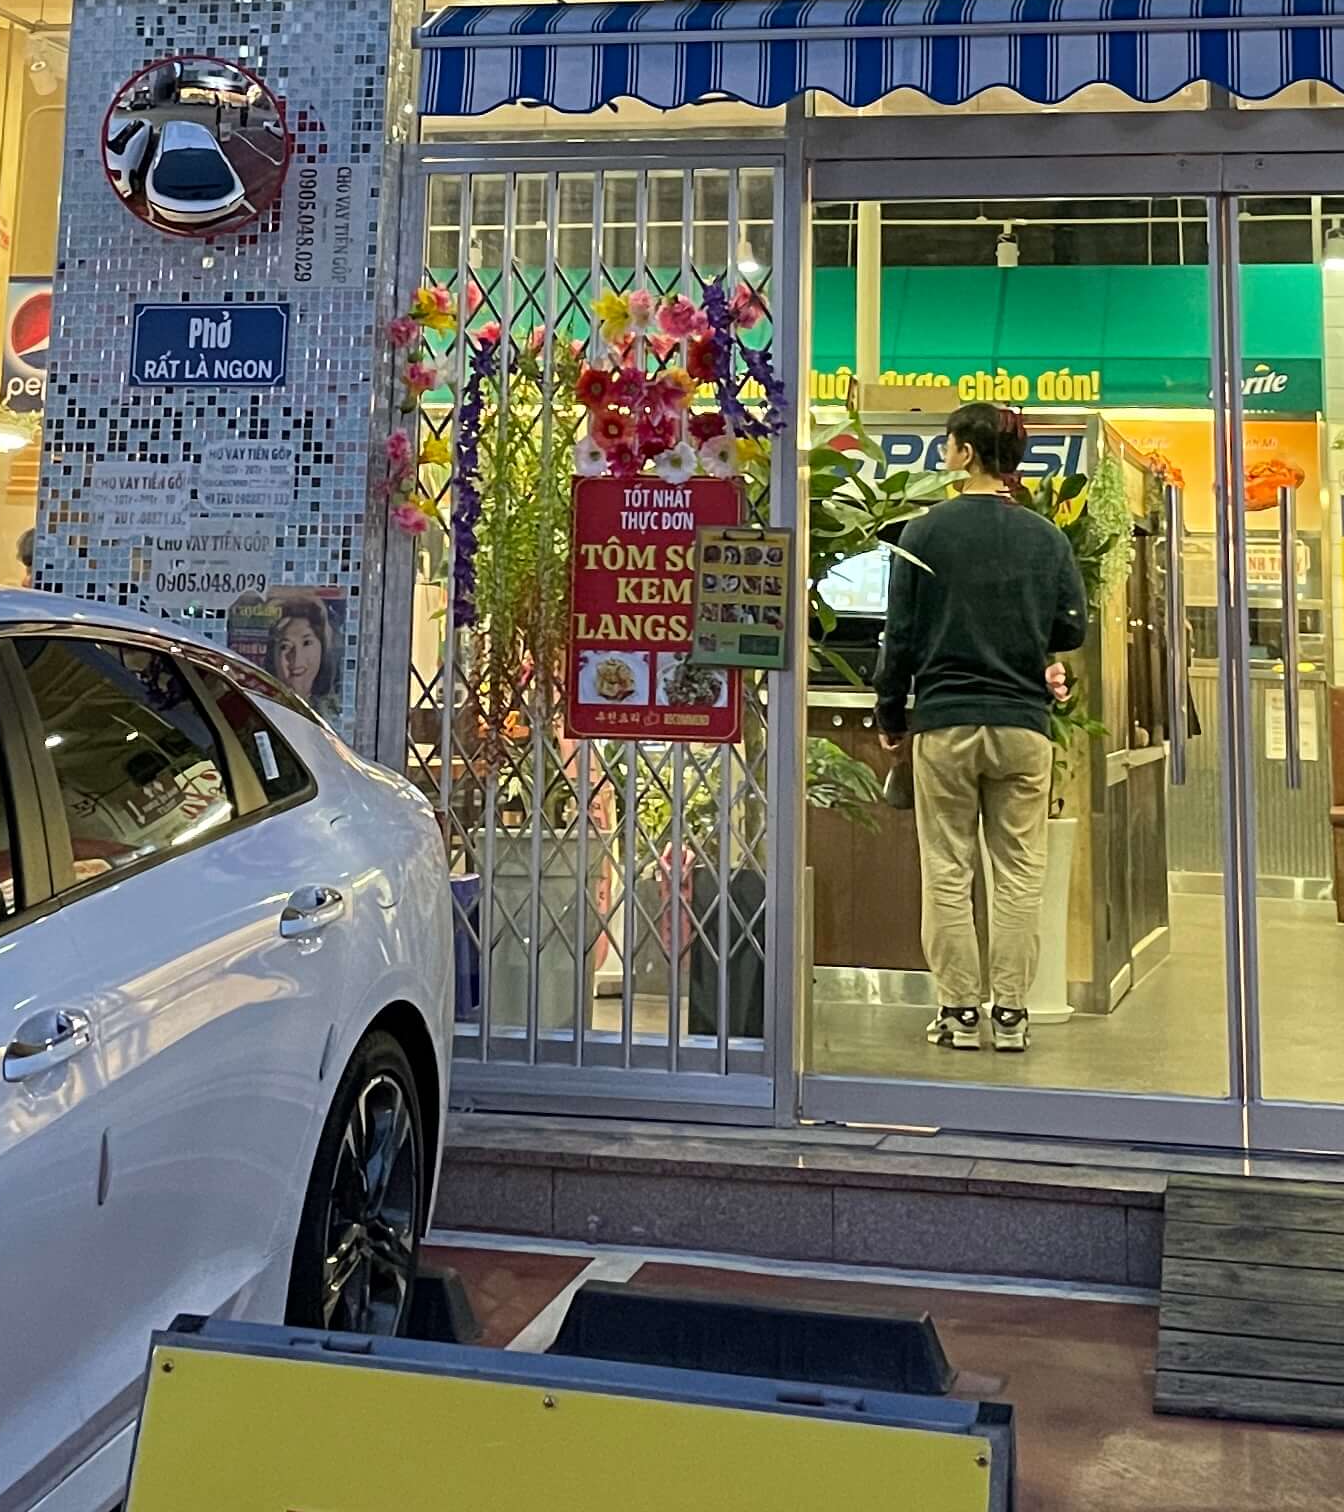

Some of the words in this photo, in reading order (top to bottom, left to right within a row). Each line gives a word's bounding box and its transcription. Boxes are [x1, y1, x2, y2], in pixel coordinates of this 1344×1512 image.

[294, 168, 318, 283] 0905.048.029
[188, 310, 232, 349] Phở
[144, 350, 180, 379] RẤT
[184, 353, 209, 379] LÀ
[214, 359, 273, 379] NGON
[958, 367, 1030, 401] chào
[1037, 368, 1100, 401] đón!
[875, 434, 1084, 479] PESI
[624, 483, 650, 507] TỐT
[653, 484, 692, 508] NHẤT
[620, 511, 659, 535] THỰC
[661, 511, 694, 530] ĐƠN
[580, 535, 656, 571] TÔM
[617, 578, 693, 604] KEM
[576, 614, 694, 641] LANGS
